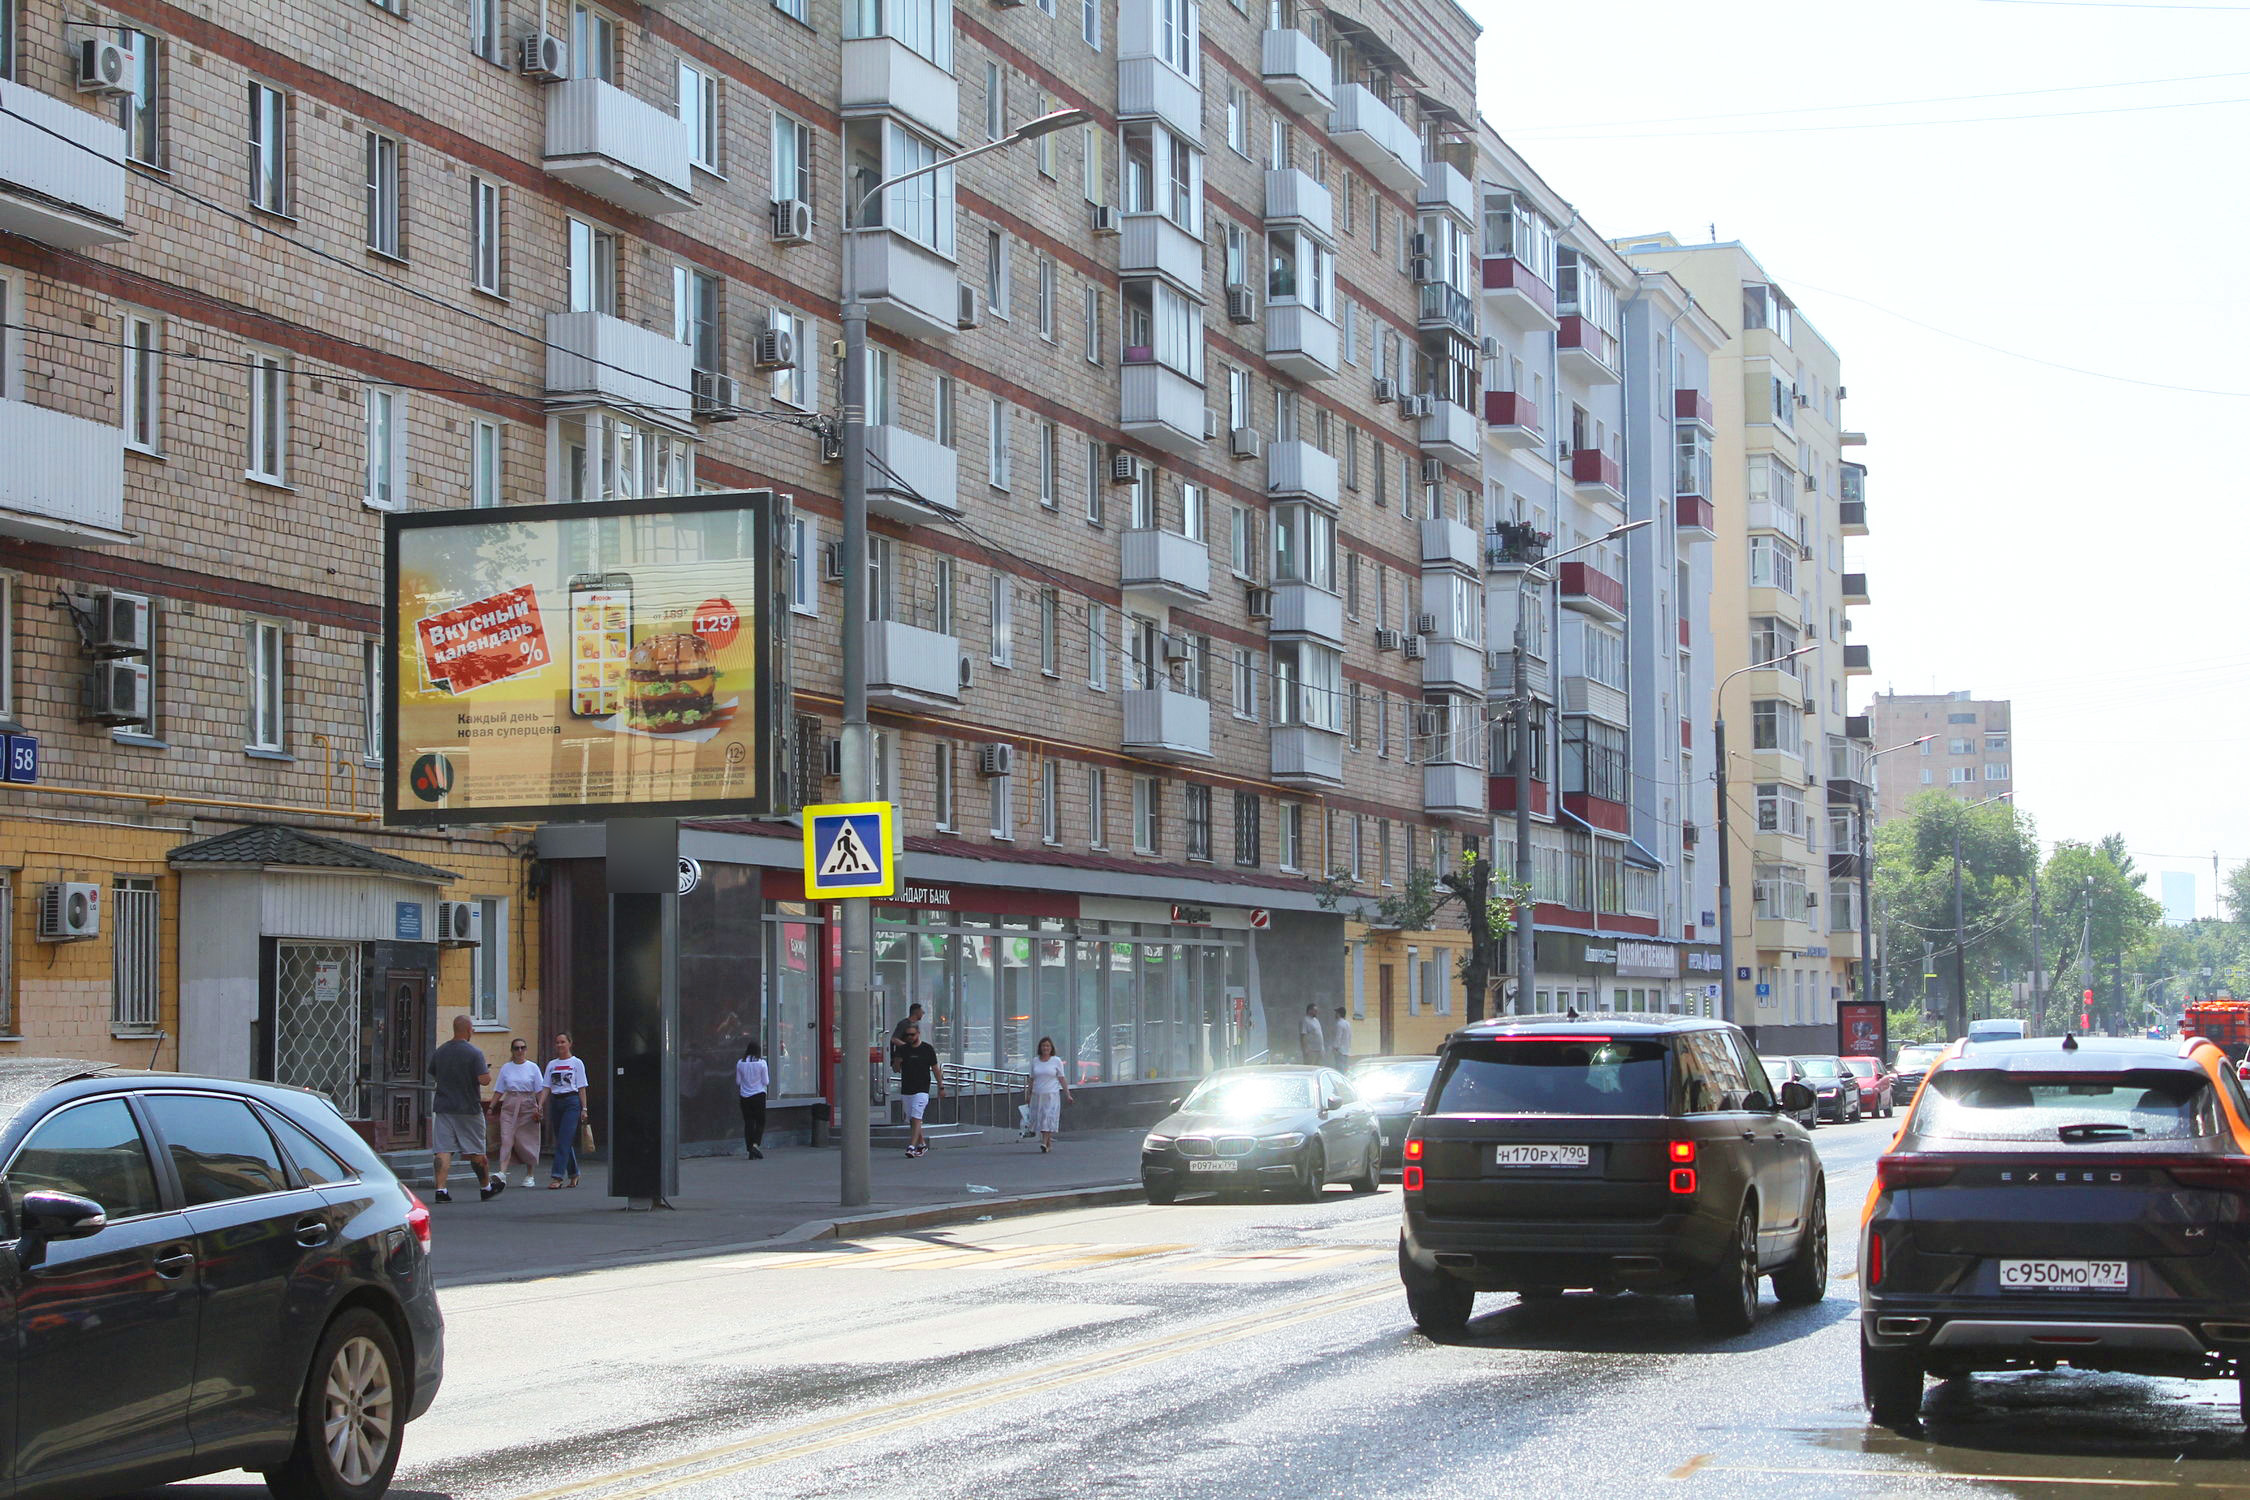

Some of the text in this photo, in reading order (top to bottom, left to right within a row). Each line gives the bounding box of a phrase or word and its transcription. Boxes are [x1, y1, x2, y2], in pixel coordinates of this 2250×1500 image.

[429, 595, 529, 646] Вкусный
[433, 622, 533, 664] календарь
[520, 637, 544, 665] %
[457, 712, 507, 725] Каждый
[509, 712, 540, 724] день
[457, 725, 561, 739] новая суперцена
[15, 747, 33, 771] 58
[729, 747, 743, 759] 12+
[929, 888, 950, 905] БАНК
[1617, 941, 1675, 969] ХОЗЯЙСТВЕННЫЙ
[1740, 968, 1748, 978] 8
[1501, 1146, 1585, 1162] Н170РХ 790
[2001, 1172, 2122, 1181] EXEED
[2006, 1263, 2122, 1284] С950МО 797
